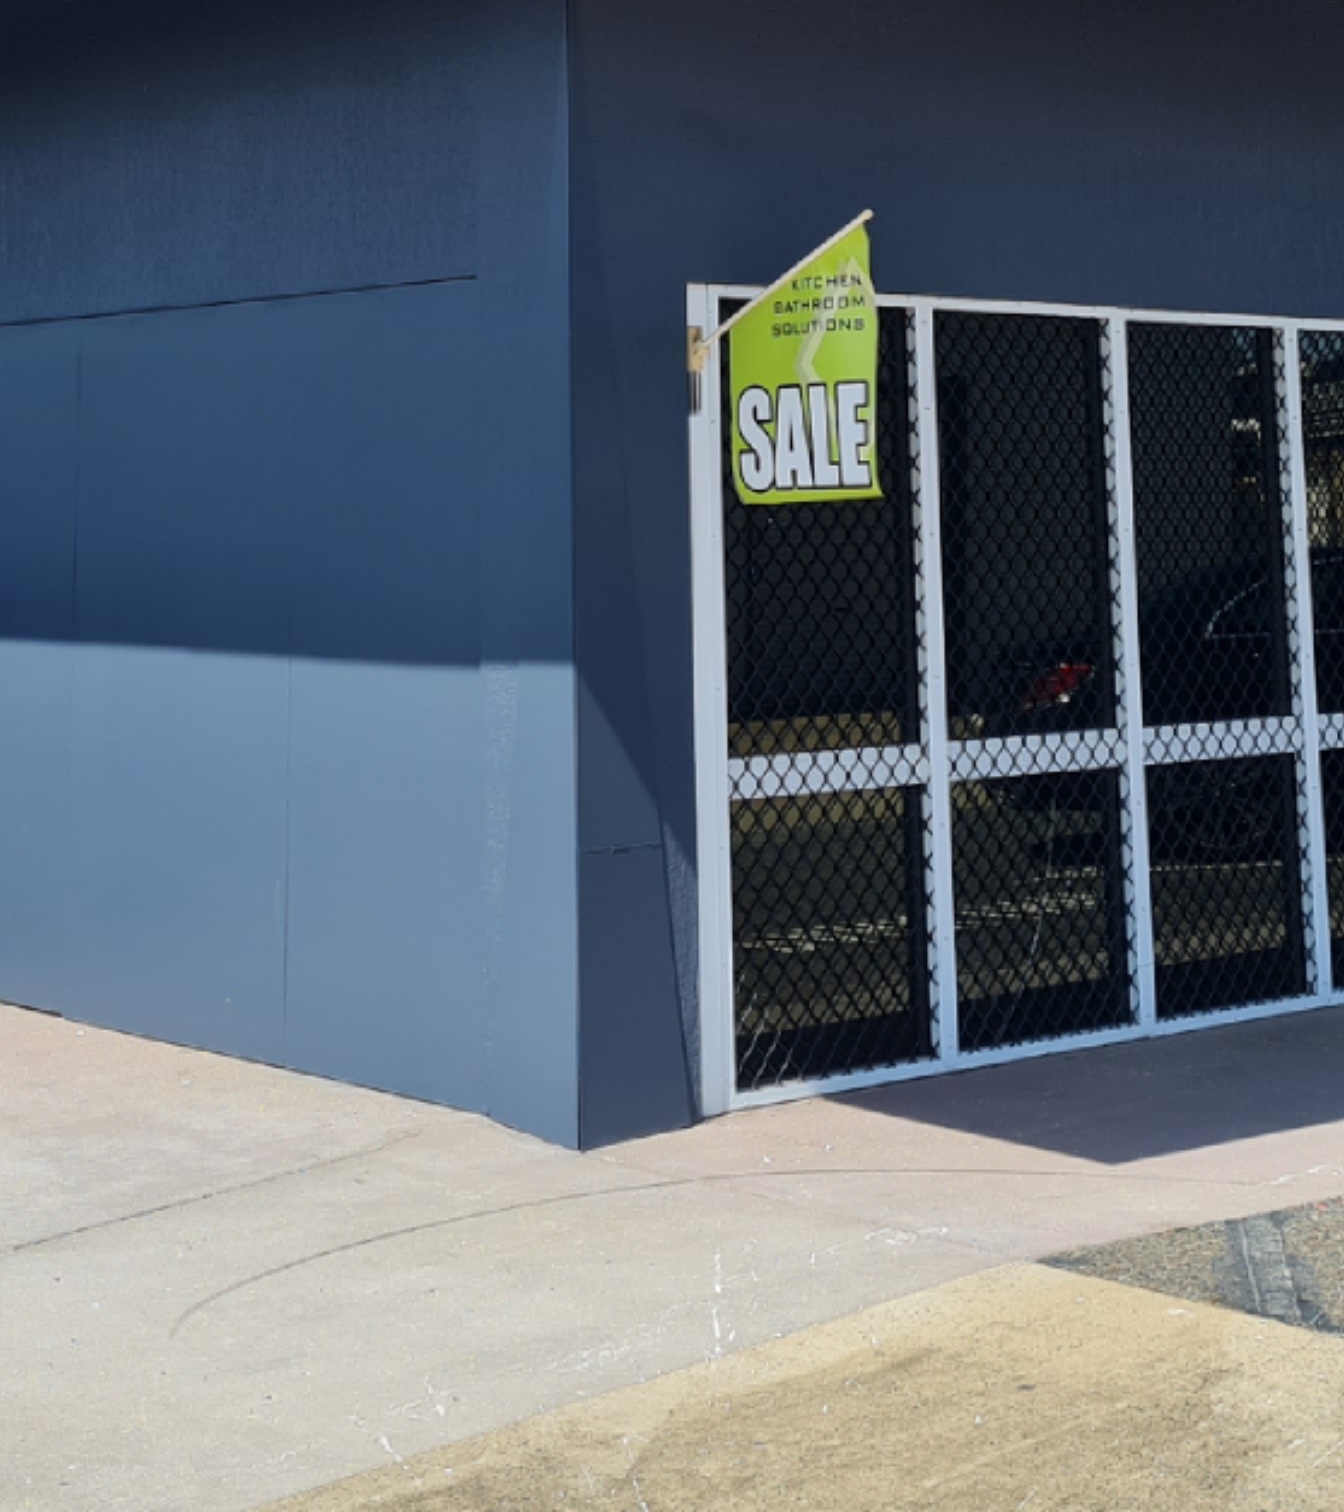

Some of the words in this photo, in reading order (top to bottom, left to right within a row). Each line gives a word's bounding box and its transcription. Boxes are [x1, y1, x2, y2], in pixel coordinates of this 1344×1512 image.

[791, 273, 863, 290] KITCHEN
[773, 296, 866, 314] BATHROOM
[771, 318, 865, 336] SOLUTIONS
[737, 380, 873, 494] SALE
